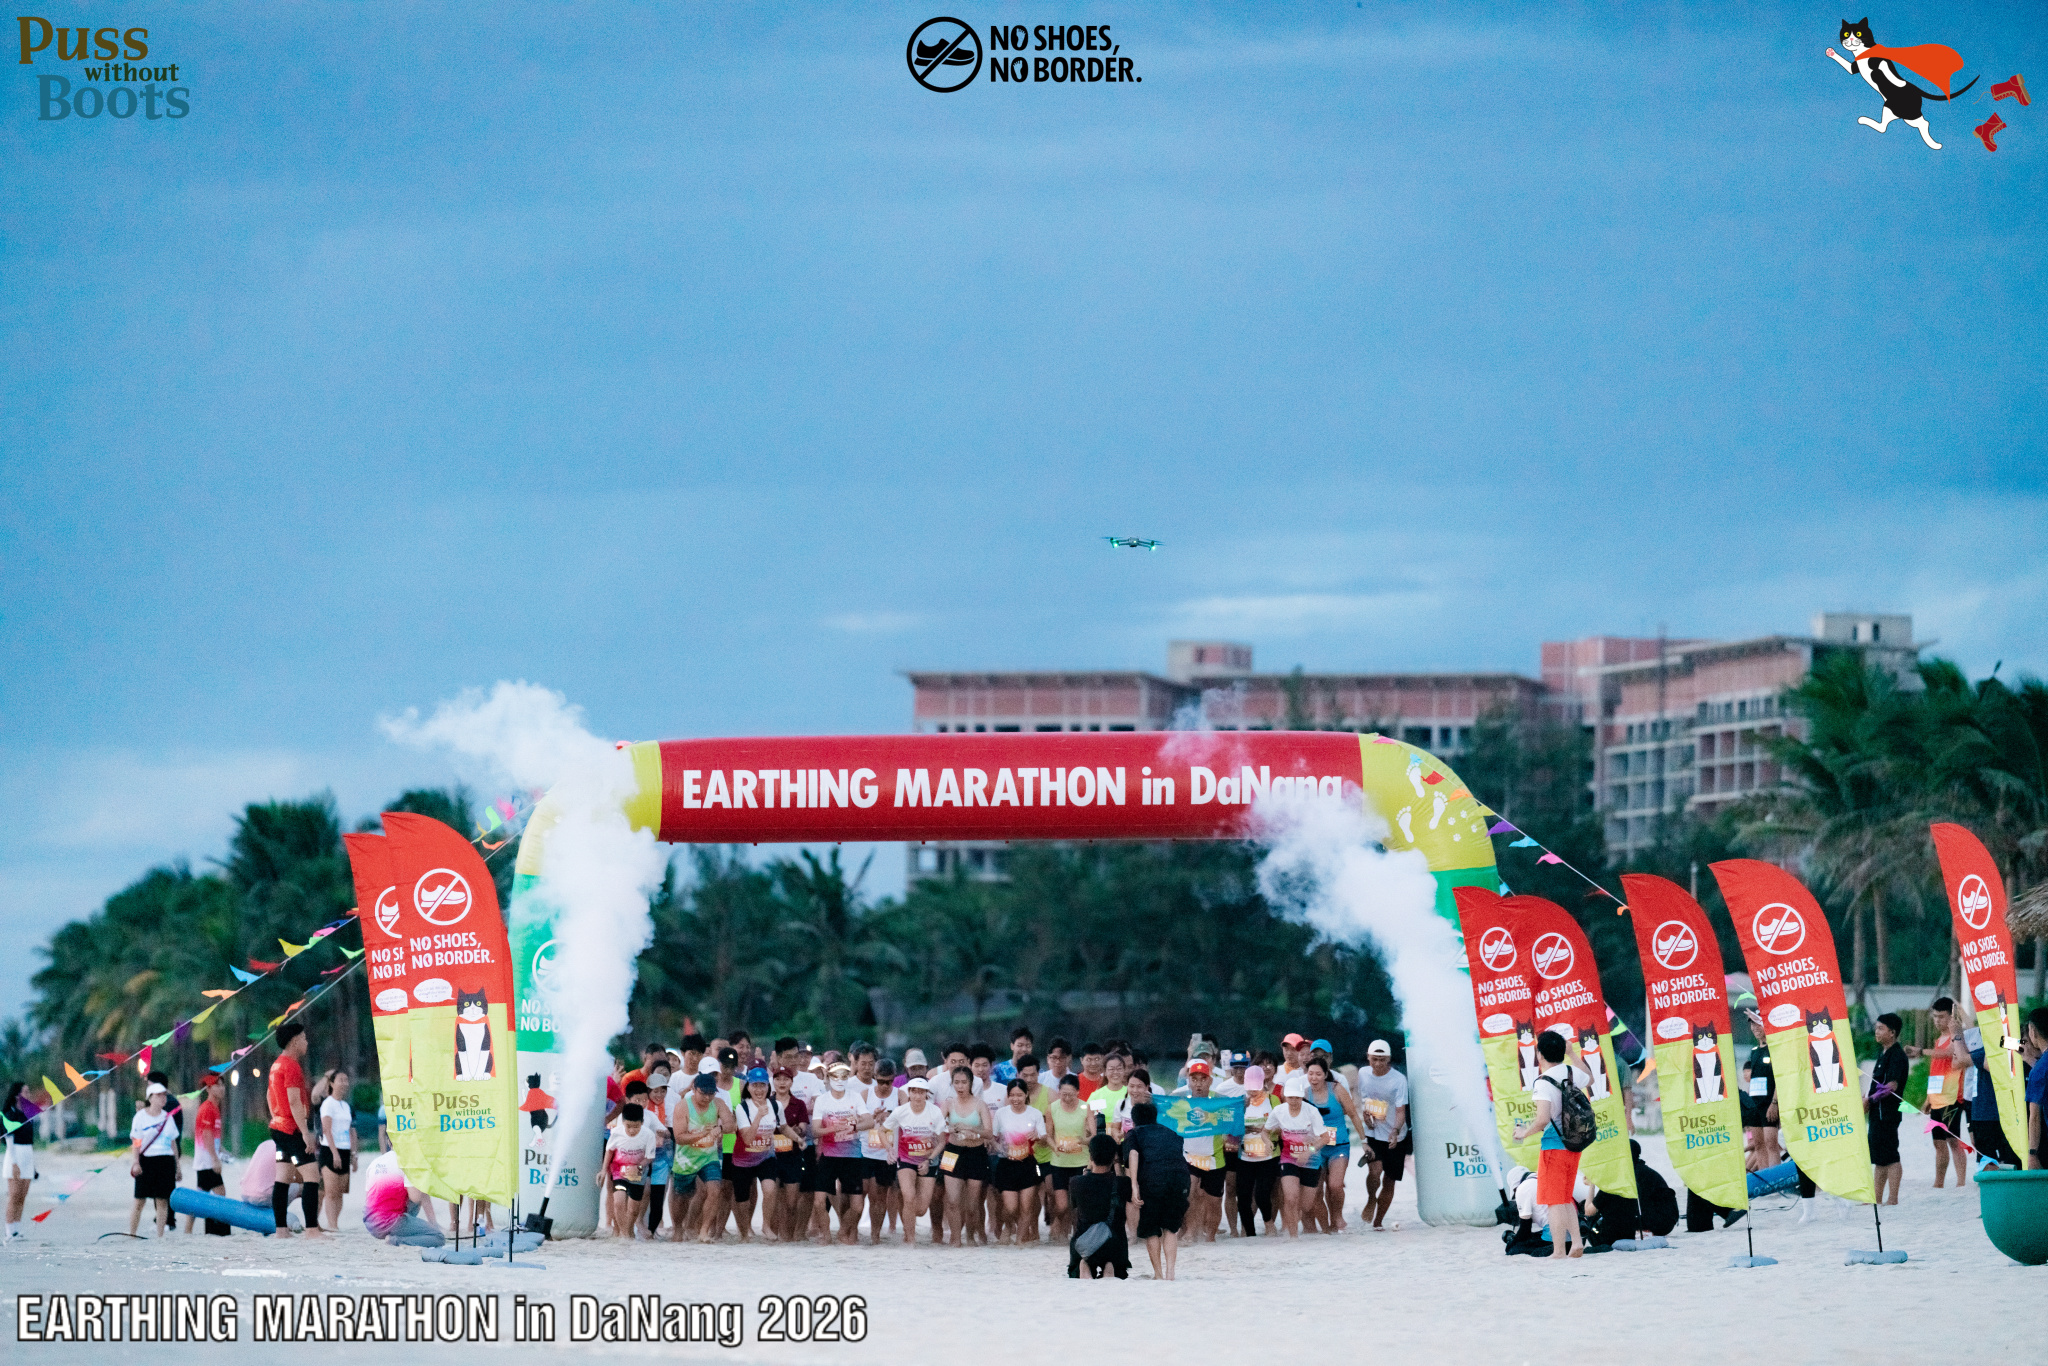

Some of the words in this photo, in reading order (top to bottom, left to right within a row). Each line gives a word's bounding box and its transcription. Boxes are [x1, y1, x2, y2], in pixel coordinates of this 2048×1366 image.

[683, 768, 879, 809] EARTHING
[893, 766, 1126, 807] MARATHON
[1142, 766, 1175, 806] in
[410, 936, 432, 952] NO
[433, 931, 481, 949] SHOES,
[371, 948, 391, 964] NO
[411, 953, 433, 969] NO
[435, 949, 495, 966] BORDER.
[372, 964, 393, 980] NO
[1756, 966, 1777, 983] NO
[1777, 956, 1819, 977] SHOES,
[1478, 980, 1494, 994] NO
[1651, 980, 1669, 995] NO
[1669, 973, 1708, 992] SHOES,
[1760, 981, 1781, 998] NO
[1780, 971, 1834, 993] BORDER.
[1479, 993, 1497, 1007] NO
[1535, 990, 1550, 1005] NO
[1535, 1003, 1554, 1019] NO
[1553, 992, 1598, 1014] BORDER.
[1654, 995, 1671, 1010] NO
[1671, 987, 1720, 1006] BORDER.
[520, 1016, 540, 1032] NO
[390, 1094, 413, 1112] Pu
[432, 1092, 480, 1112] Puss
[455, 1107, 492, 1117] without
[1795, 1104, 1839, 1125] Puss
[439, 1114, 496, 1132] Boots
[1678, 1114, 1716, 1132] Puss
[1595, 1126, 1619, 1142] oots
[1685, 1131, 1731, 1150] Boots
[1806, 1122, 1854, 1143] Boots
[1445, 1142, 1480, 1159] Pus
